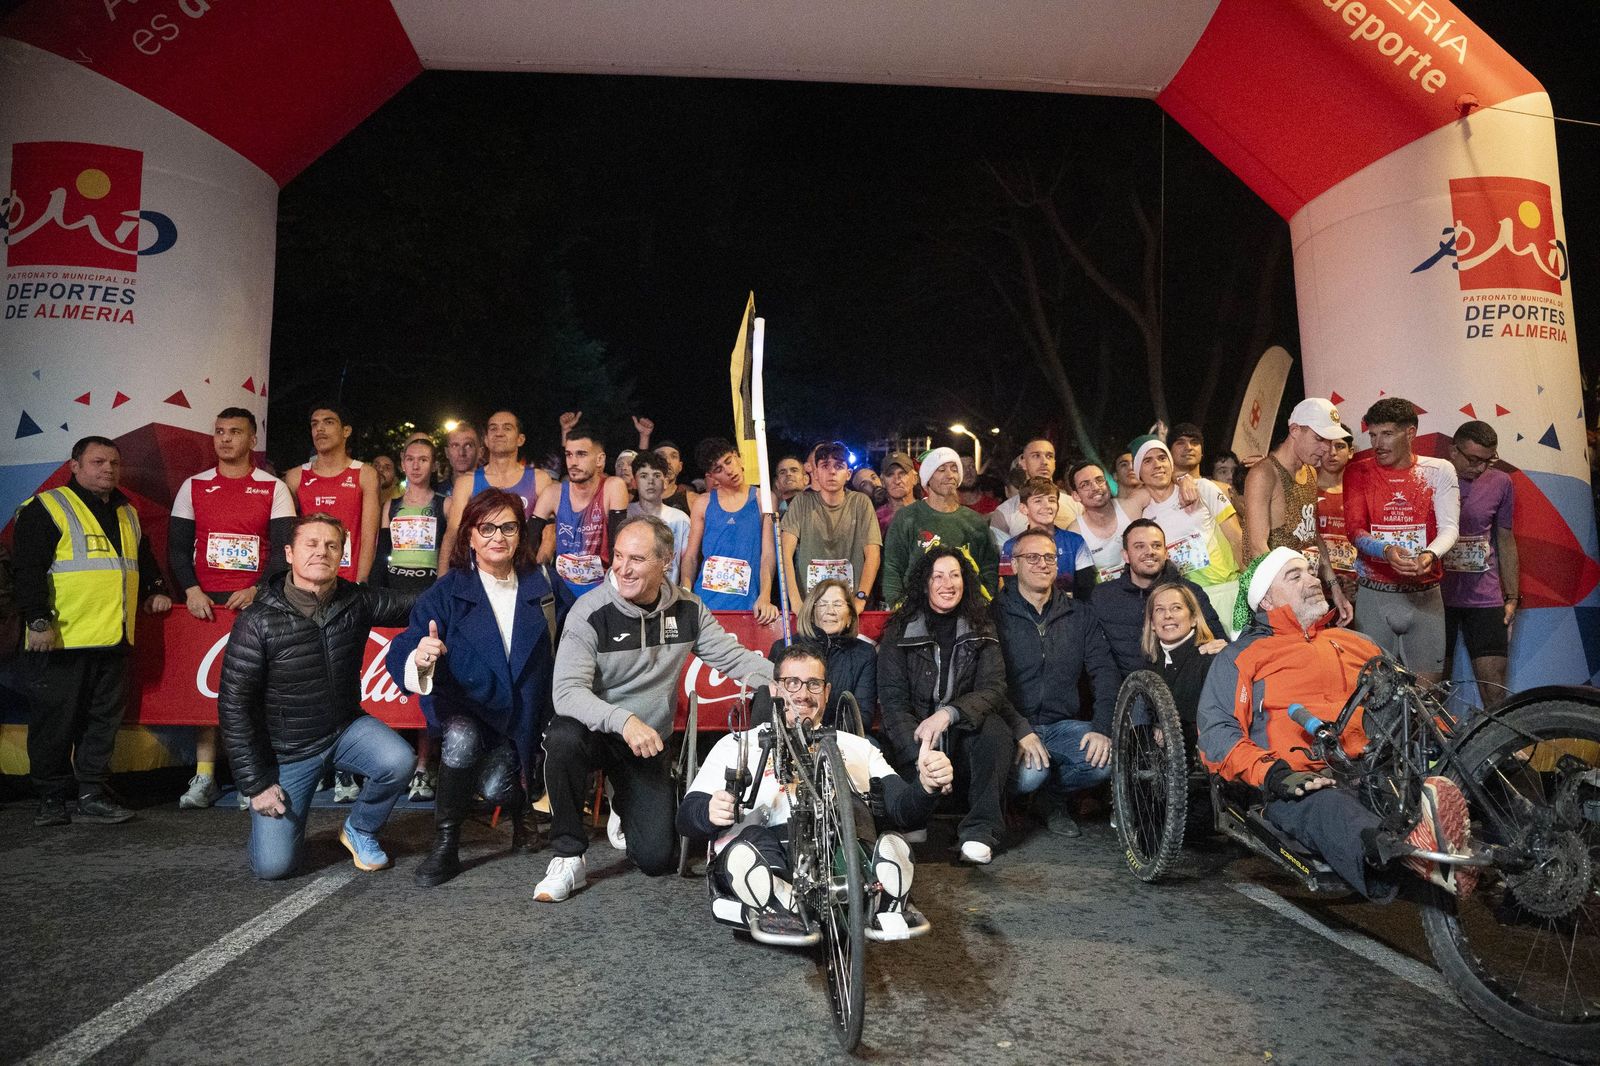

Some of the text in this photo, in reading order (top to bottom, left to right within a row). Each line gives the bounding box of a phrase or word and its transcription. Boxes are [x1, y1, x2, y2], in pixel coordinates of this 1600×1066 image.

[132, 13, 180, 56] es
[7, 271, 137, 286] PATRONATO MUNICIPAL DE
[6, 282, 136, 305] DEPORTES
[1462, 294, 1518, 303] PATRONATO
[1520, 295, 1556, 306] MUNICIPAL
[5, 303, 135, 325] DE ALMERIA
[1465, 304, 1565, 326] DEPORTES
[1466, 323, 1568, 344] DE ALMERIA
[220, 547, 248, 557] 1519
[1327, 548, 1351, 559] 2393
[1457, 551, 1484, 559] 2378
[397, 568, 426, 577] PRO
[566, 566, 592, 576] 1007
[717, 571, 735, 581] 864
[1368, 579, 1396, 592] NIKE
